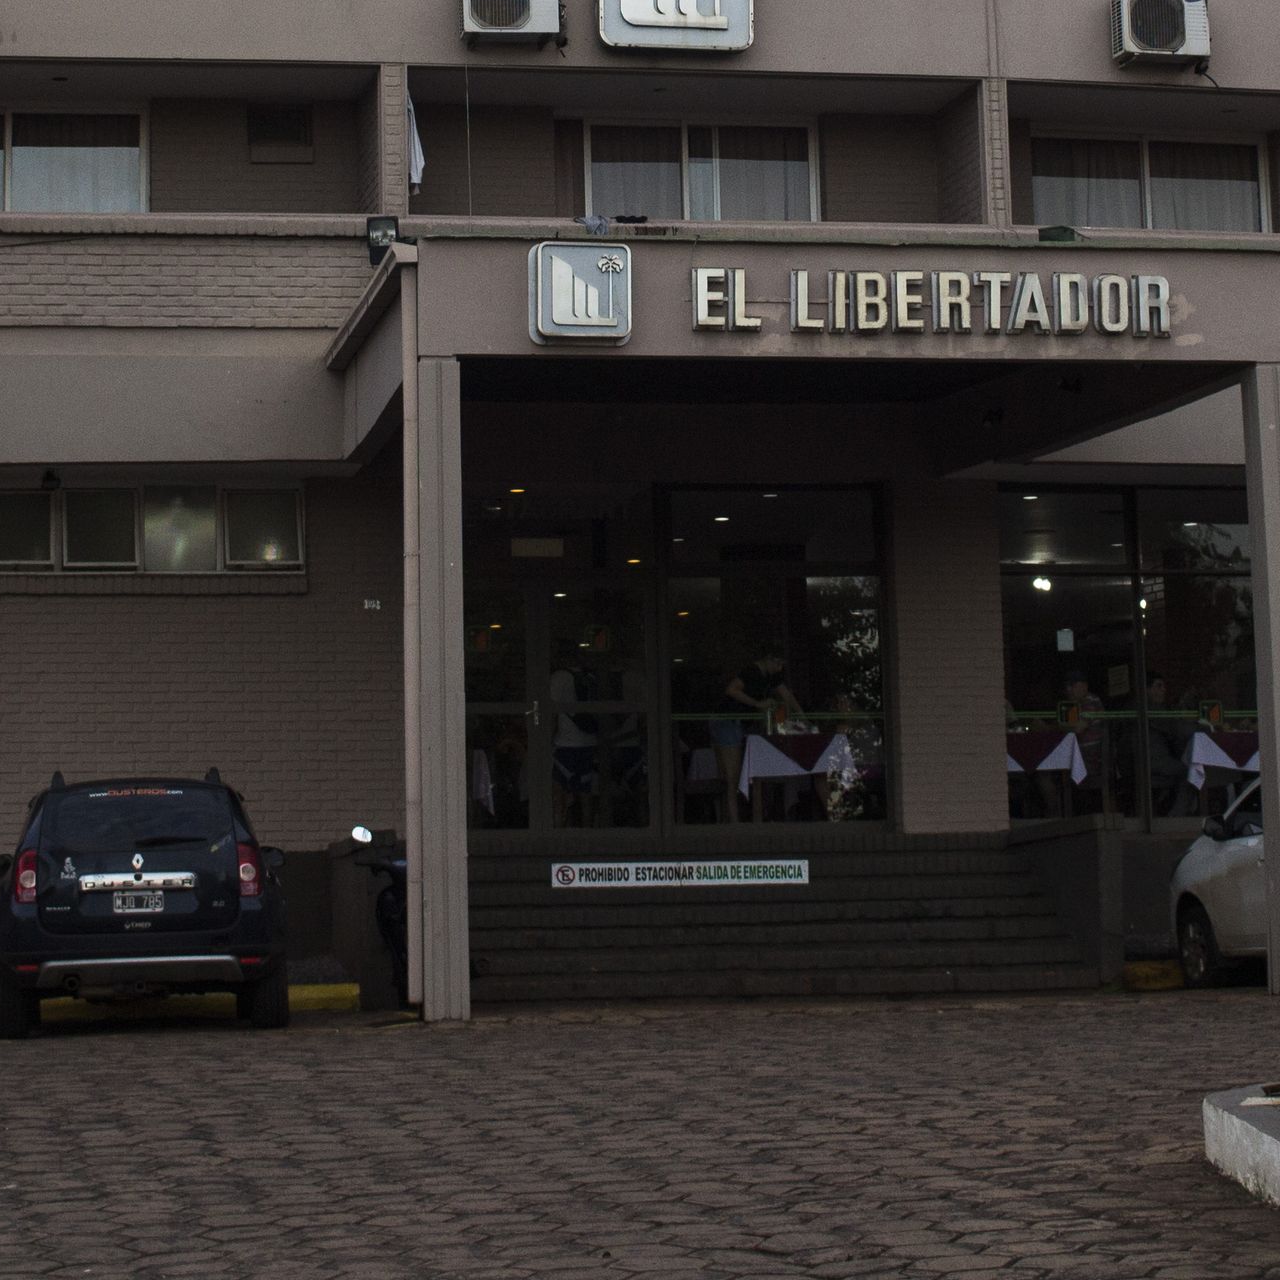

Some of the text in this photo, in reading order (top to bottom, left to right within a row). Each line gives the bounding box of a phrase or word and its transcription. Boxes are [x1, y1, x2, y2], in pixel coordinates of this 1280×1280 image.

[692, 267, 1170, 338] EL LIBERTADOR
[578, 867, 630, 882] PROHIBIDO
[635, 865, 694, 882] ESTACIONAR
[696, 865, 729, 880] SALIDA
[730, 865, 742, 880] DE
[743, 864, 802, 880] EMERGENCIA
[85, 879, 193, 889] DUSTER
[141, 895, 163, 909] 785
